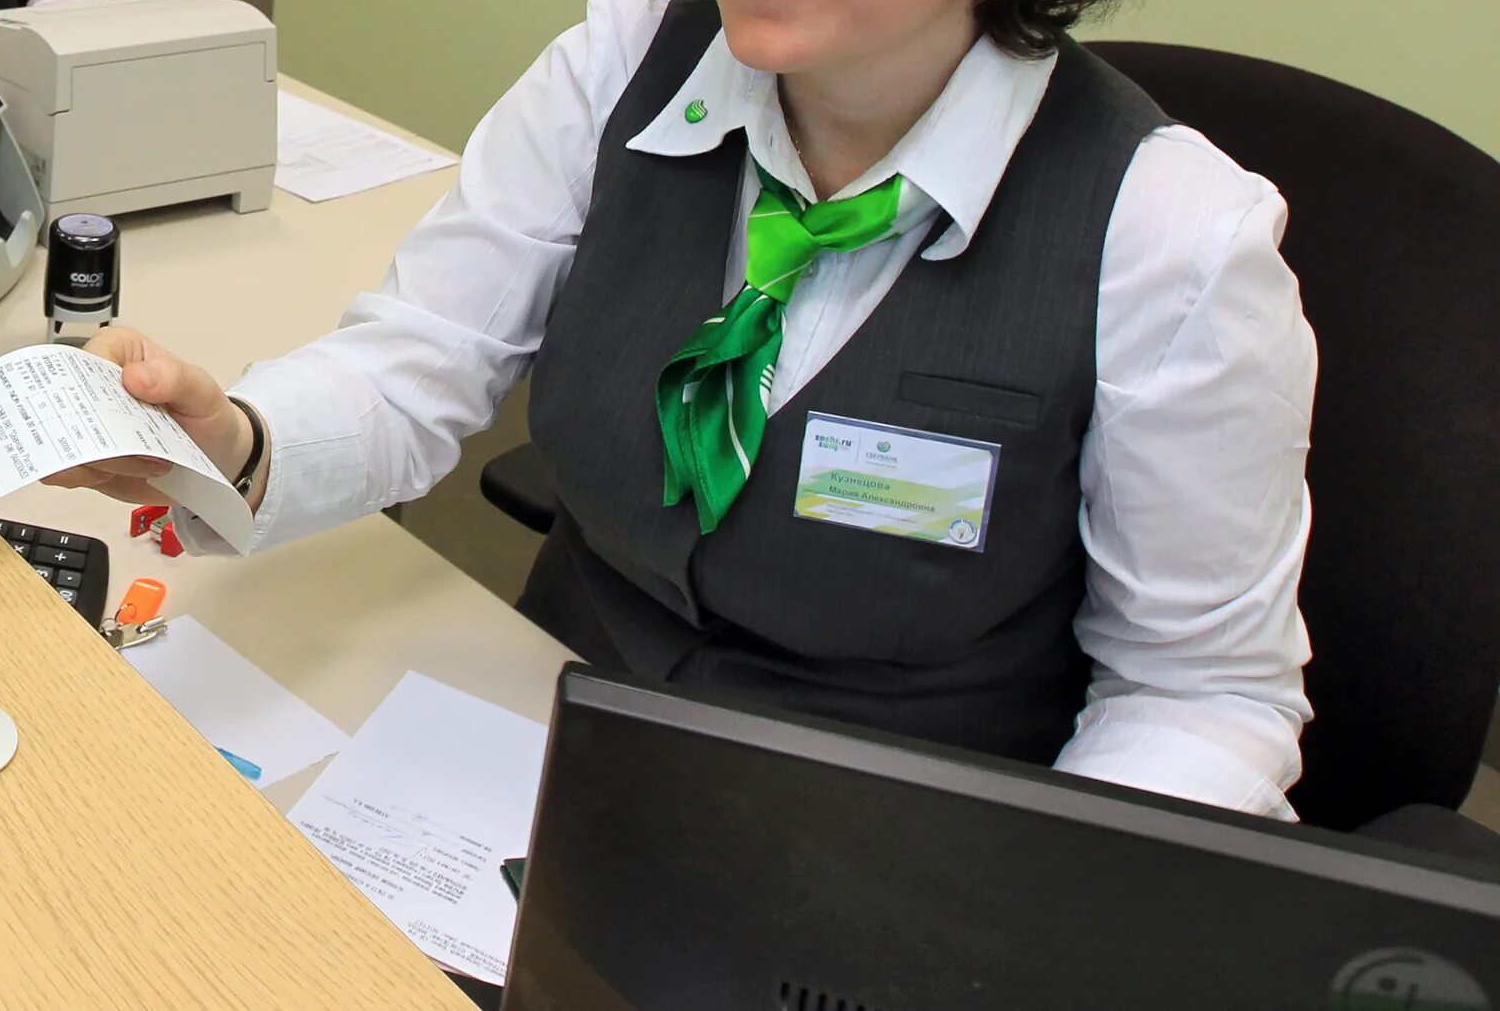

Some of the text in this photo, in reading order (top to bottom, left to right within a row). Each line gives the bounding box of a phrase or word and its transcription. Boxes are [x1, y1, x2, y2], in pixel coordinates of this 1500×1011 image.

[831, 472, 891, 491] Кузнецова
[829, 486, 936, 513] Мария Александровна
